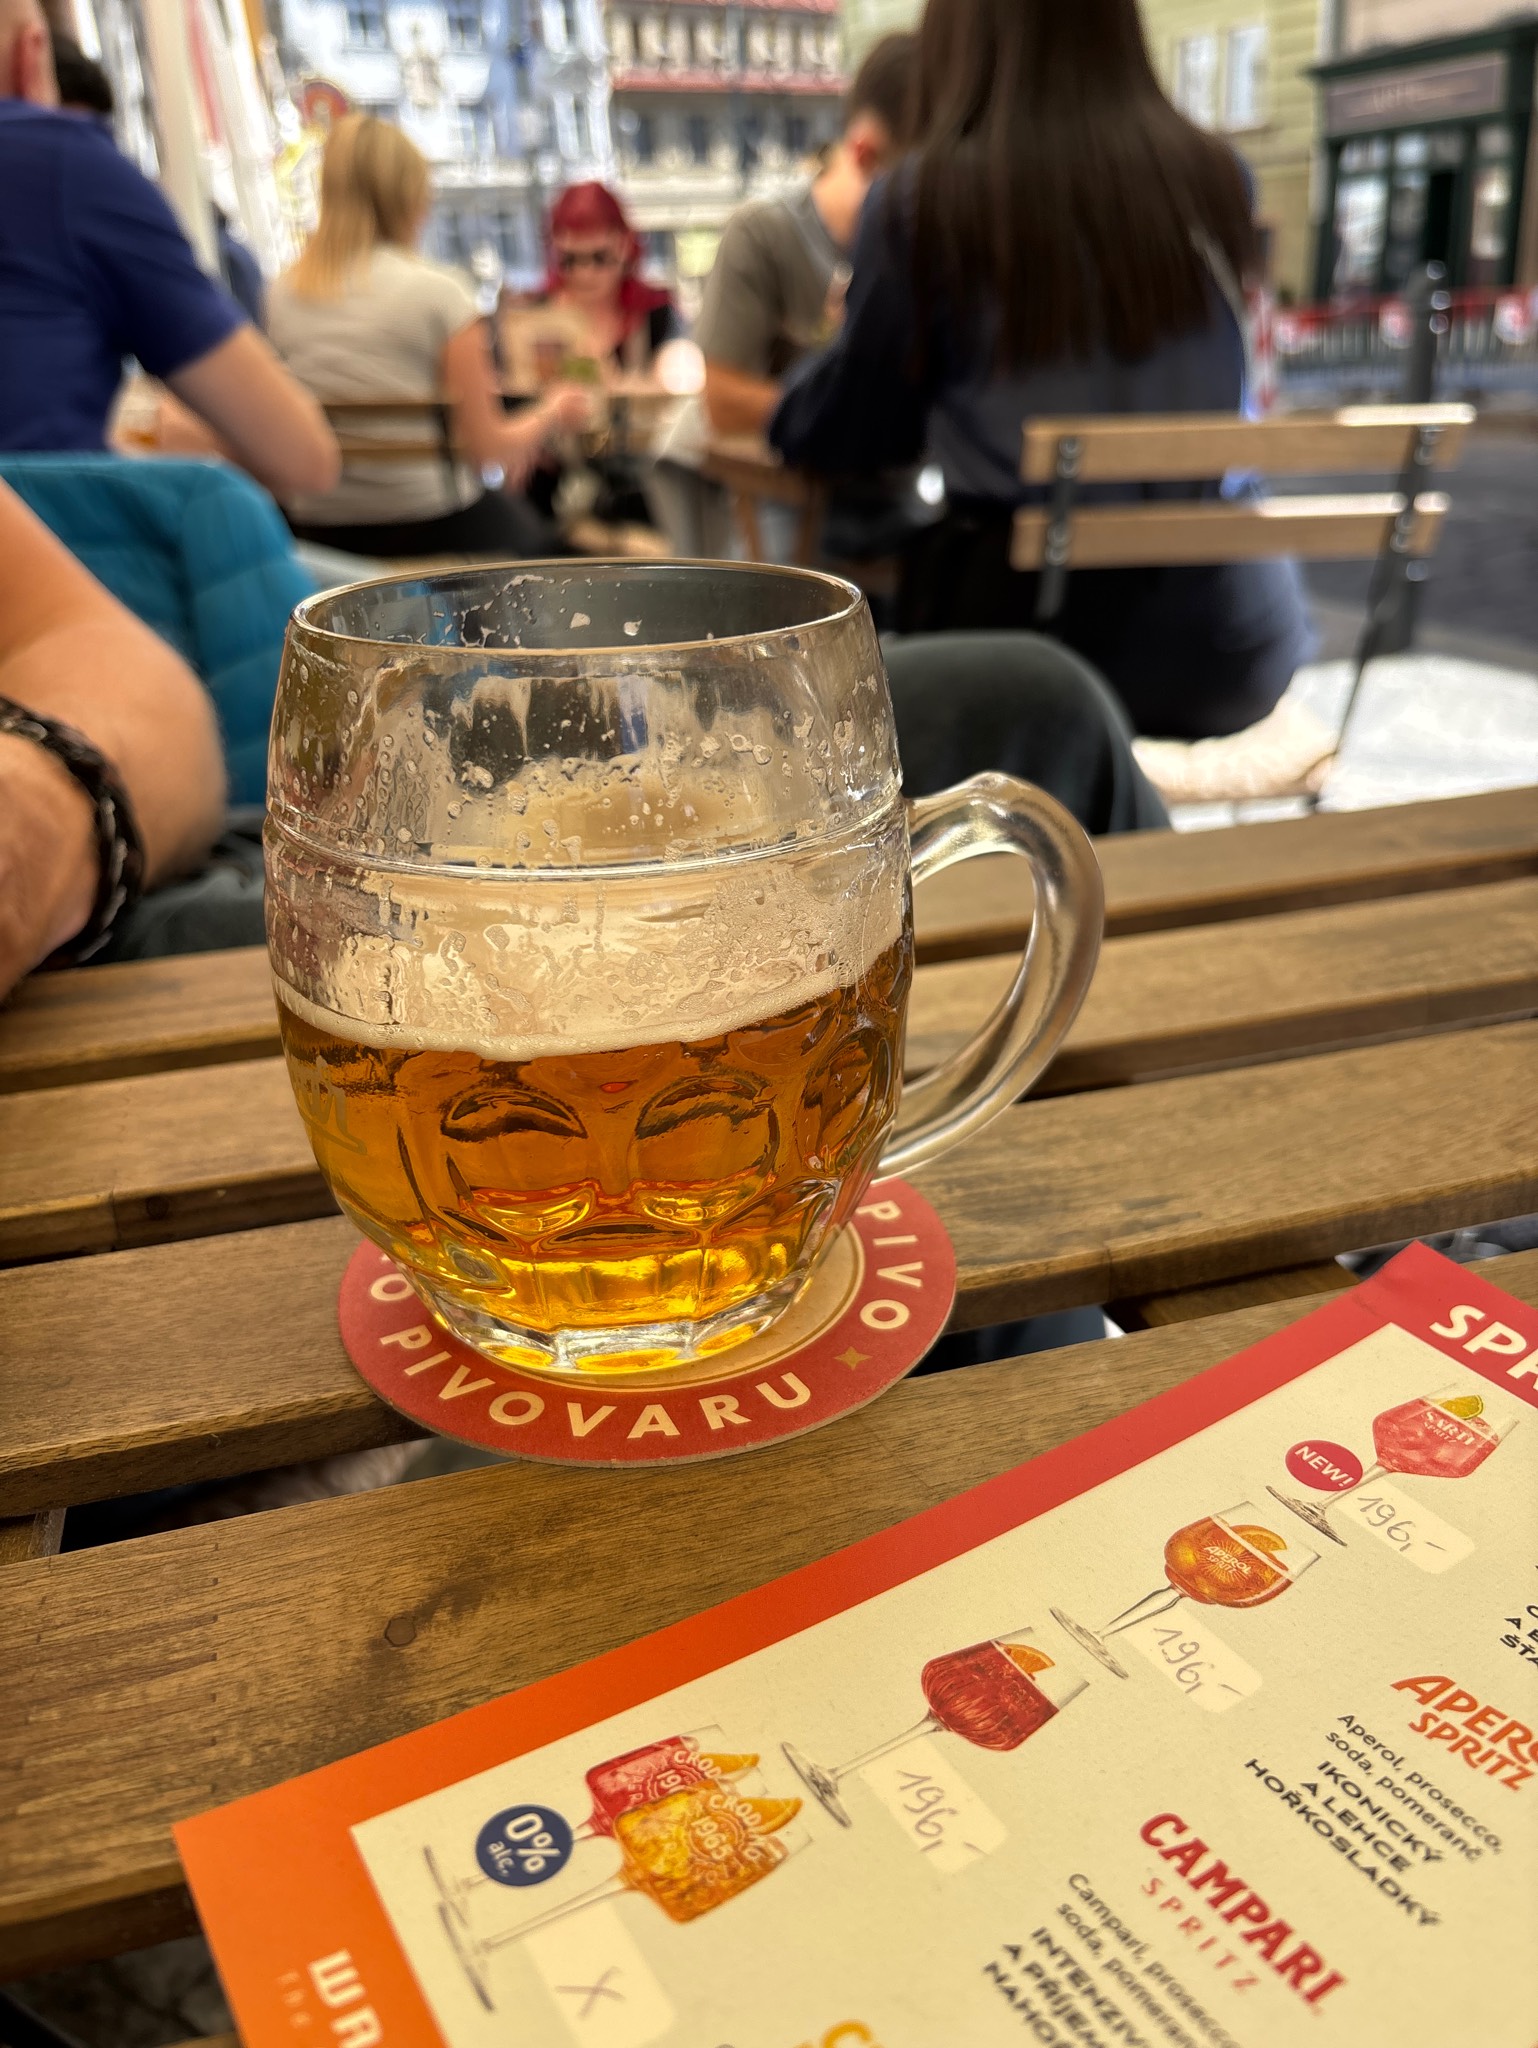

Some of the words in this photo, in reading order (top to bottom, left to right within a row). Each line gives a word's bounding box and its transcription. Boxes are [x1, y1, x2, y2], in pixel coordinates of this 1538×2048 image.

[855, 1200, 924, 1330] PIVO
[380, 1324, 811, 1439] PIVOVARU
[1294, 1444, 1355, 1490] NEW!
[1203, 1545, 1252, 1575] APEROL
[1207, 1555, 1237, 1574] SPRITZ
[1504, 1617, 1521, 1630] A
[1337, 1714, 1407, 1771] Aperol,
[1405, 1771, 1503, 1855] prosecco,
[1408, 1711, 1535, 1792] SPRITZ
[690, 1816, 735, 1861] 1965
[1300, 1782, 1318, 1796] A
[1322, 1797, 1412, 1873] LEHCE
[1317, 1760, 1444, 1864] IKONICKÝ
[1325, 1731, 1373, 1776] soda,
[1376, 1775, 1484, 1861] pomeranč
[487, 1841, 516, 1878] alc.
[504, 1811, 562, 1875] 0%
[1244, 1758, 1441, 1926] HOŘKOSLADKÝ
[1056, 1902, 1104, 1958] soda,
[1067, 1872, 1151, 1963] Campari,
[1140, 1812, 1347, 2004] CAMPARI
[1141, 1876, 1261, 1990] SPRITZ
[1002, 1943, 1023, 1961] A
